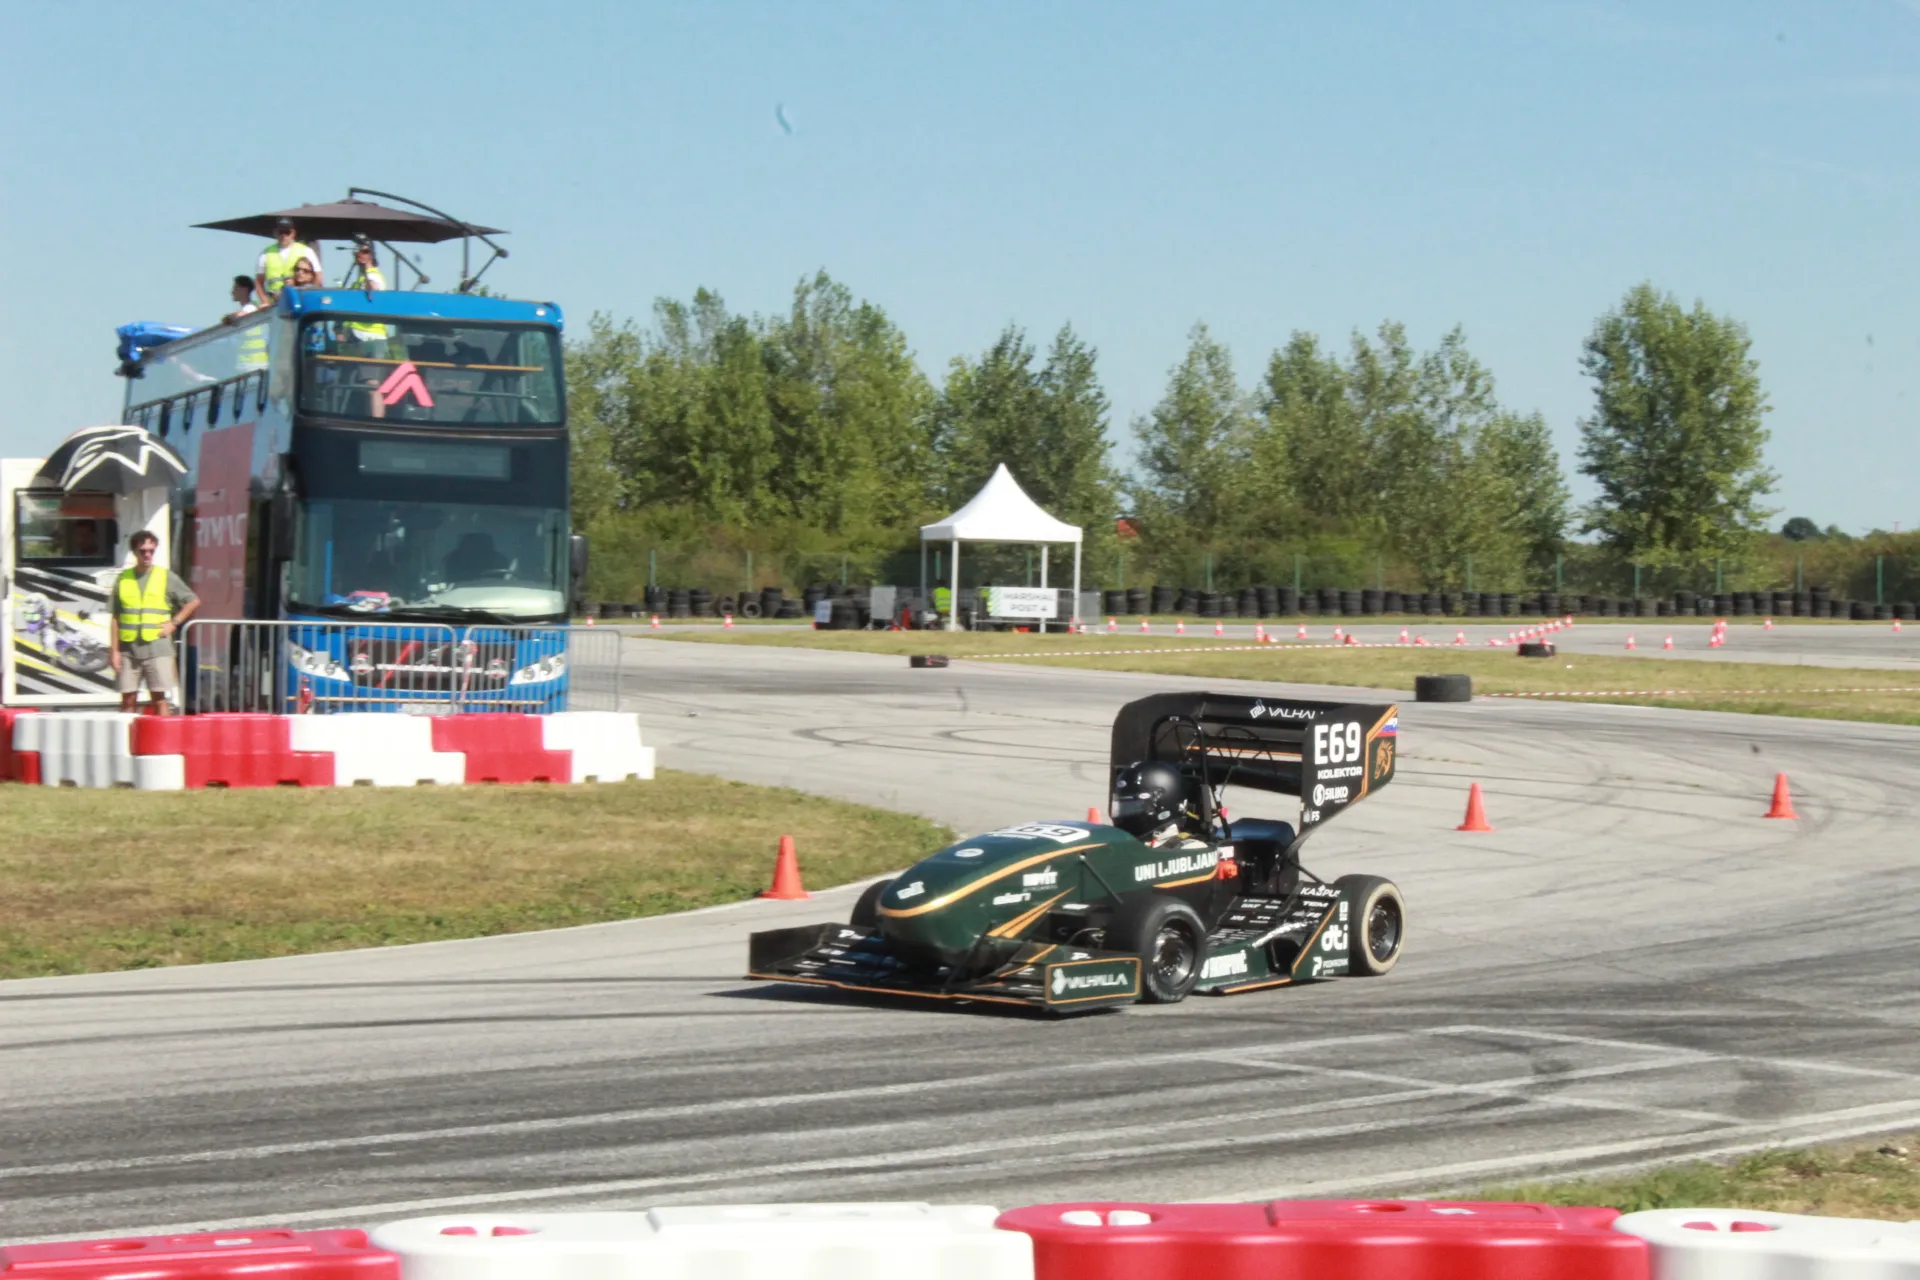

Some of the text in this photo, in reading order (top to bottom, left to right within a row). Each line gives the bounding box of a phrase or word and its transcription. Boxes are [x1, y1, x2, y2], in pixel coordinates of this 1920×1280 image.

[1010, 604, 1038, 612] POST
[1314, 722, 1361, 765] E69
[1317, 766, 1362, 779] KOLEKTOR
[1325, 786, 1348, 800] SILIKO
[1134, 850, 1219, 881] UNI LJUBLJAN
